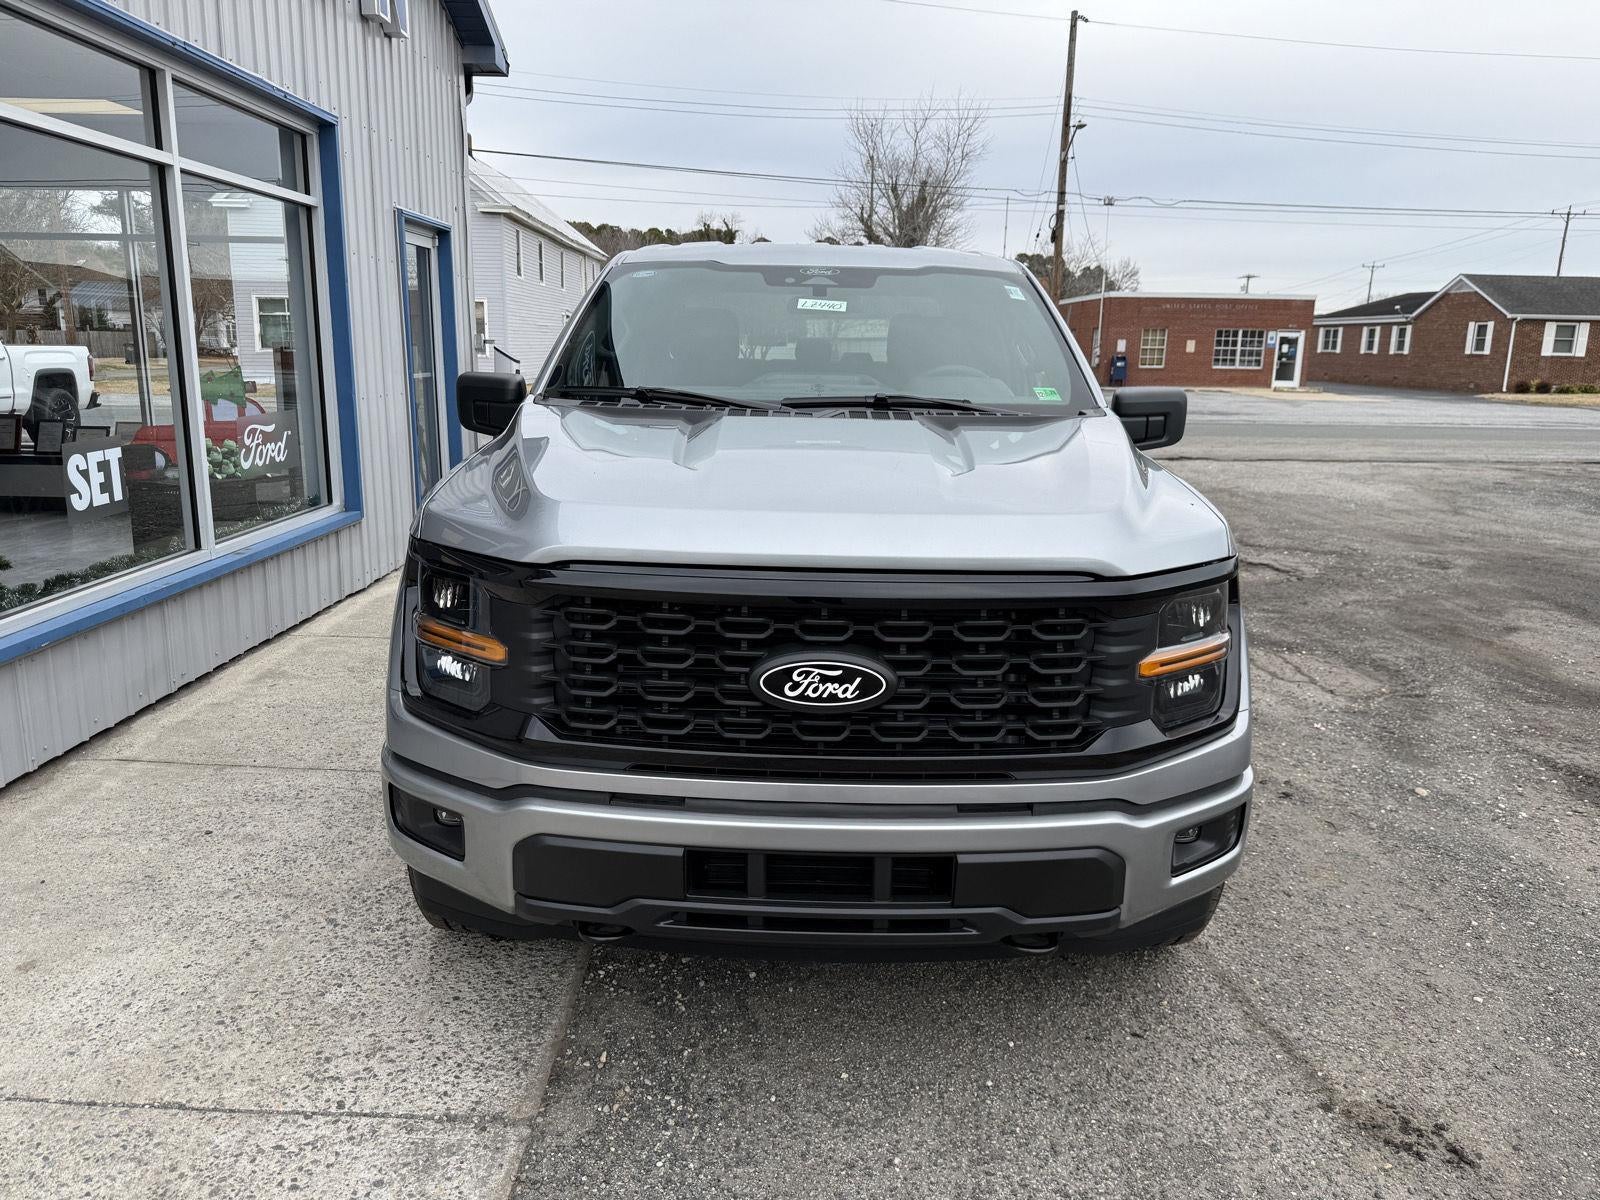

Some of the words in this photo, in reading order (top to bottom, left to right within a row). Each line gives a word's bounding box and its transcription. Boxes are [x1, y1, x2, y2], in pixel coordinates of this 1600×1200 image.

[240, 423, 289, 470] Ford
[67, 447, 123, 511] SET
[784, 667, 863, 699] Ford
